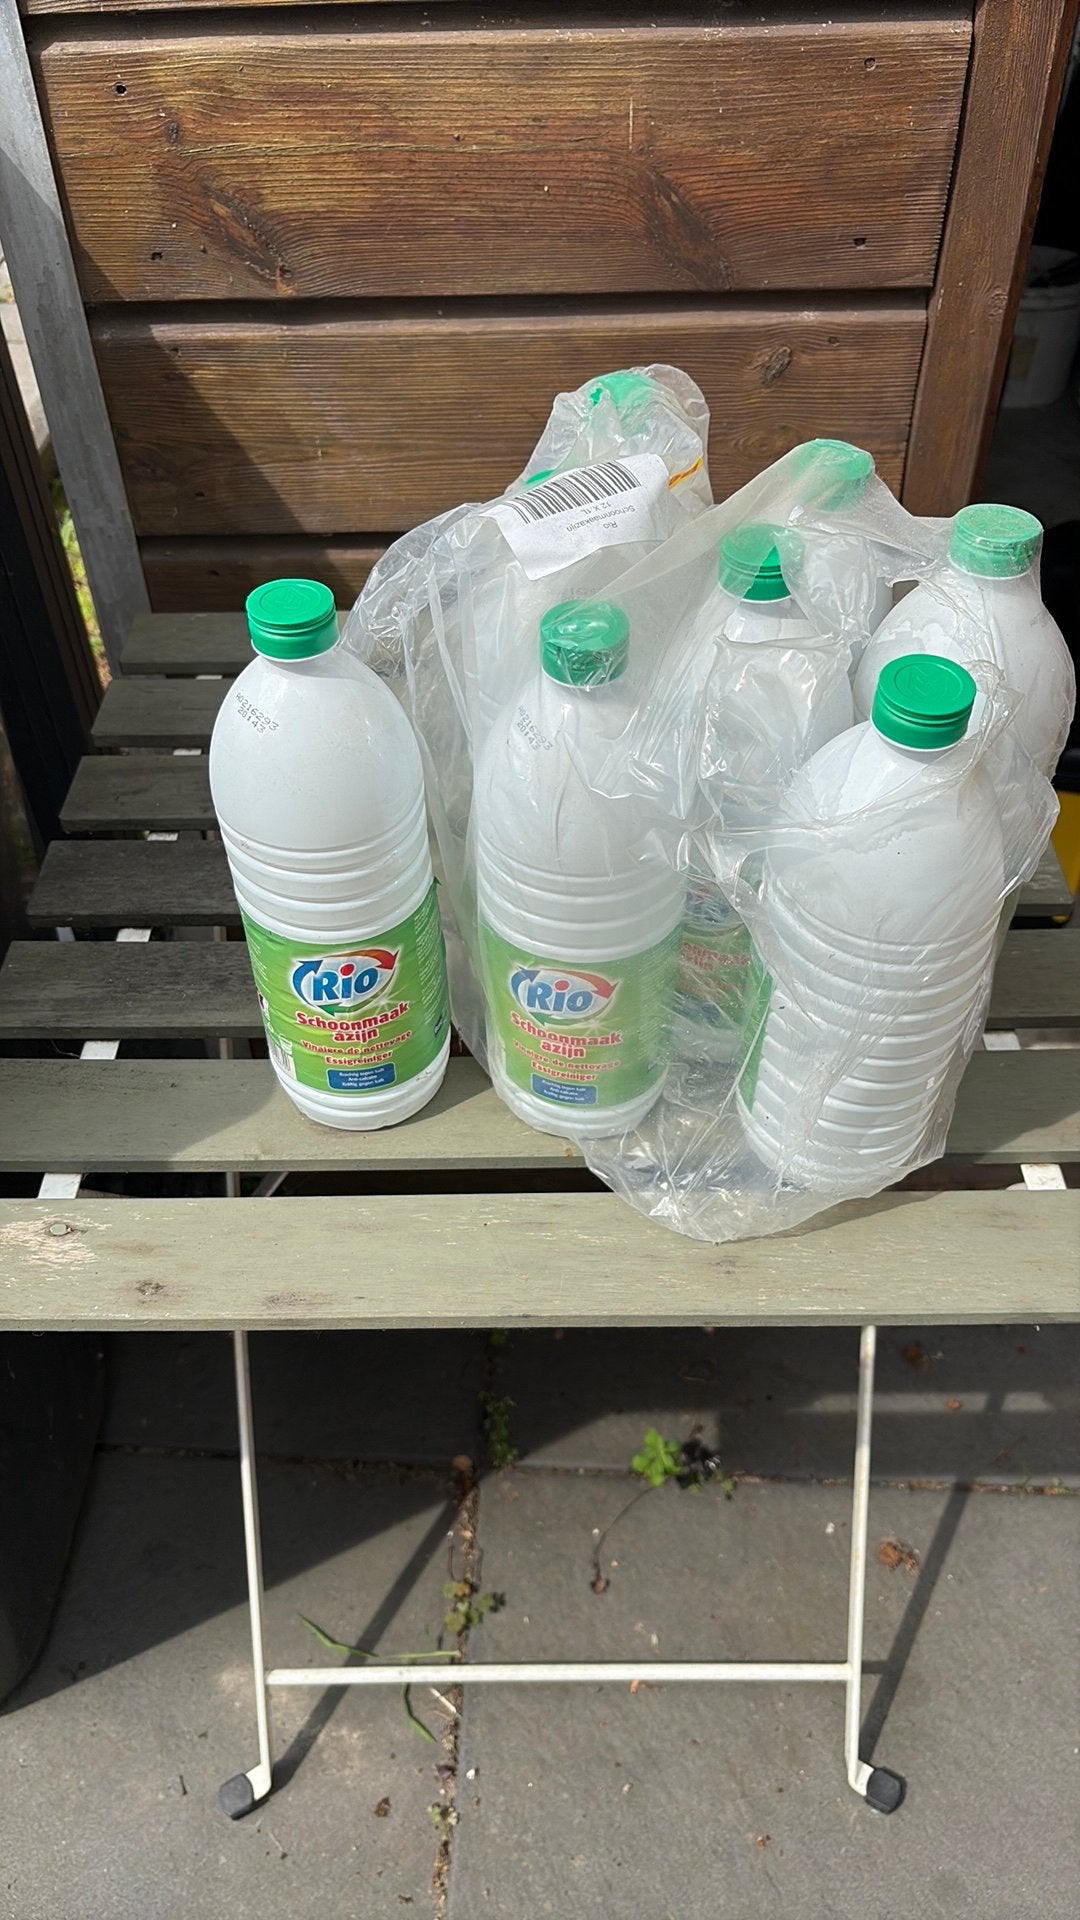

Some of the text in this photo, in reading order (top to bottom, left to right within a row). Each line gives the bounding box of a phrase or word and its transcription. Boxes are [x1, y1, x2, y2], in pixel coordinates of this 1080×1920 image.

[600, 501, 611, 509] 12
[566, 505, 635, 532] Schoonmaakazijn
[296, 1002, 409, 1031] Schoonmaak
[334, 1028, 378, 1042] azijn
[511, 1012, 622, 1046] Schoonmaak
[302, 1040, 343, 1054] Vinaigre
[363, 1031, 411, 1053] nettoyage
[541, 1041, 585, 1058] azijn
[325, 1051, 392, 1065] Essigreiniger
[552, 1059, 565, 1067] de
[567, 1061, 620, 1070] nettoyage
[531, 1061, 596, 1080] Essigreiniger
